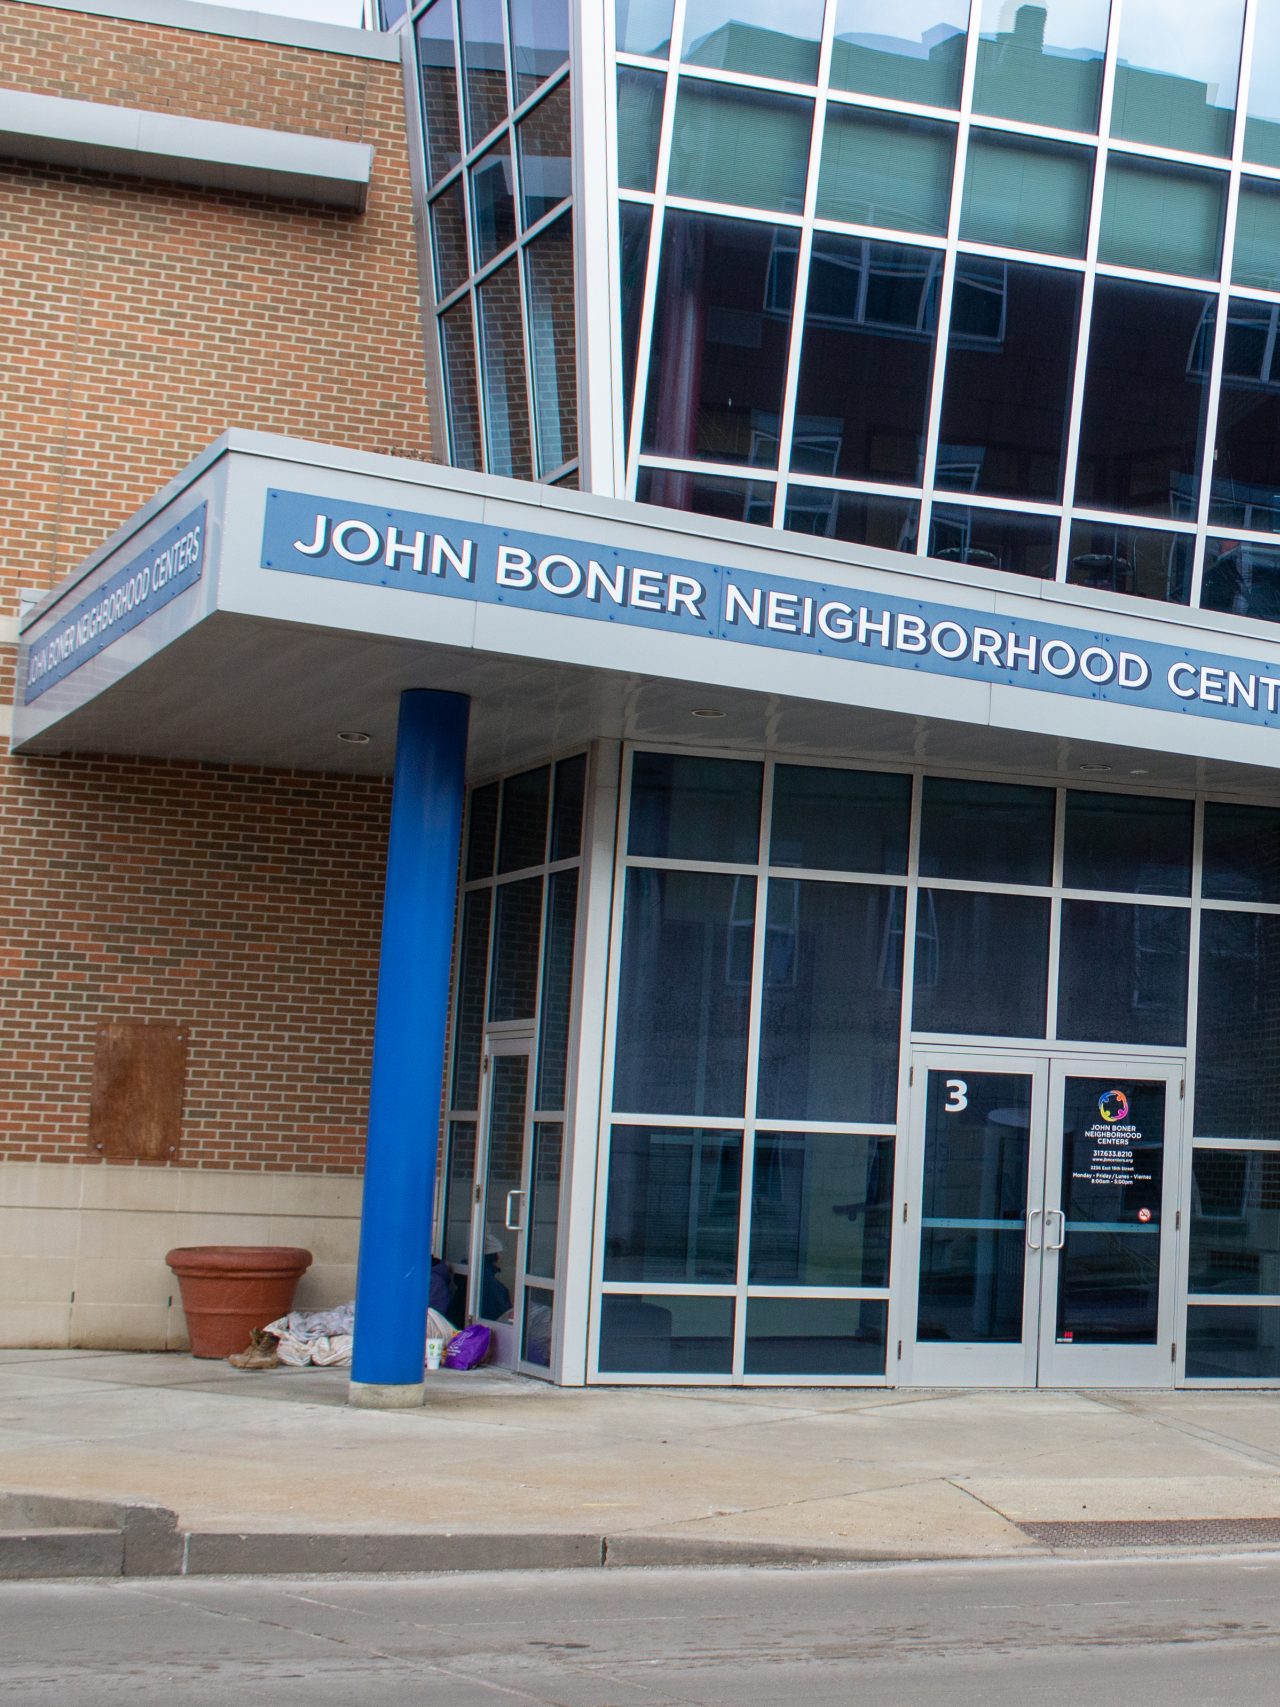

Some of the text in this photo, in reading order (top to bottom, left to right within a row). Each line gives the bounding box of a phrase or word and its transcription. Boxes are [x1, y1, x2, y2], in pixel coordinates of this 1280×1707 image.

[47, 625, 76, 671] BONER
[76, 566, 150, 649] NEIGHBORHOOD
[152, 525, 201, 592] CENTERS
[293, 514, 473, 580] JOHN
[496, 545, 703, 618] BONER
[725, 584, 1149, 689] NEIGHBORHOOD
[944, 1079, 968, 1113] 3
[1084, 1131, 1142, 1139] NEIGHBORHOOD
